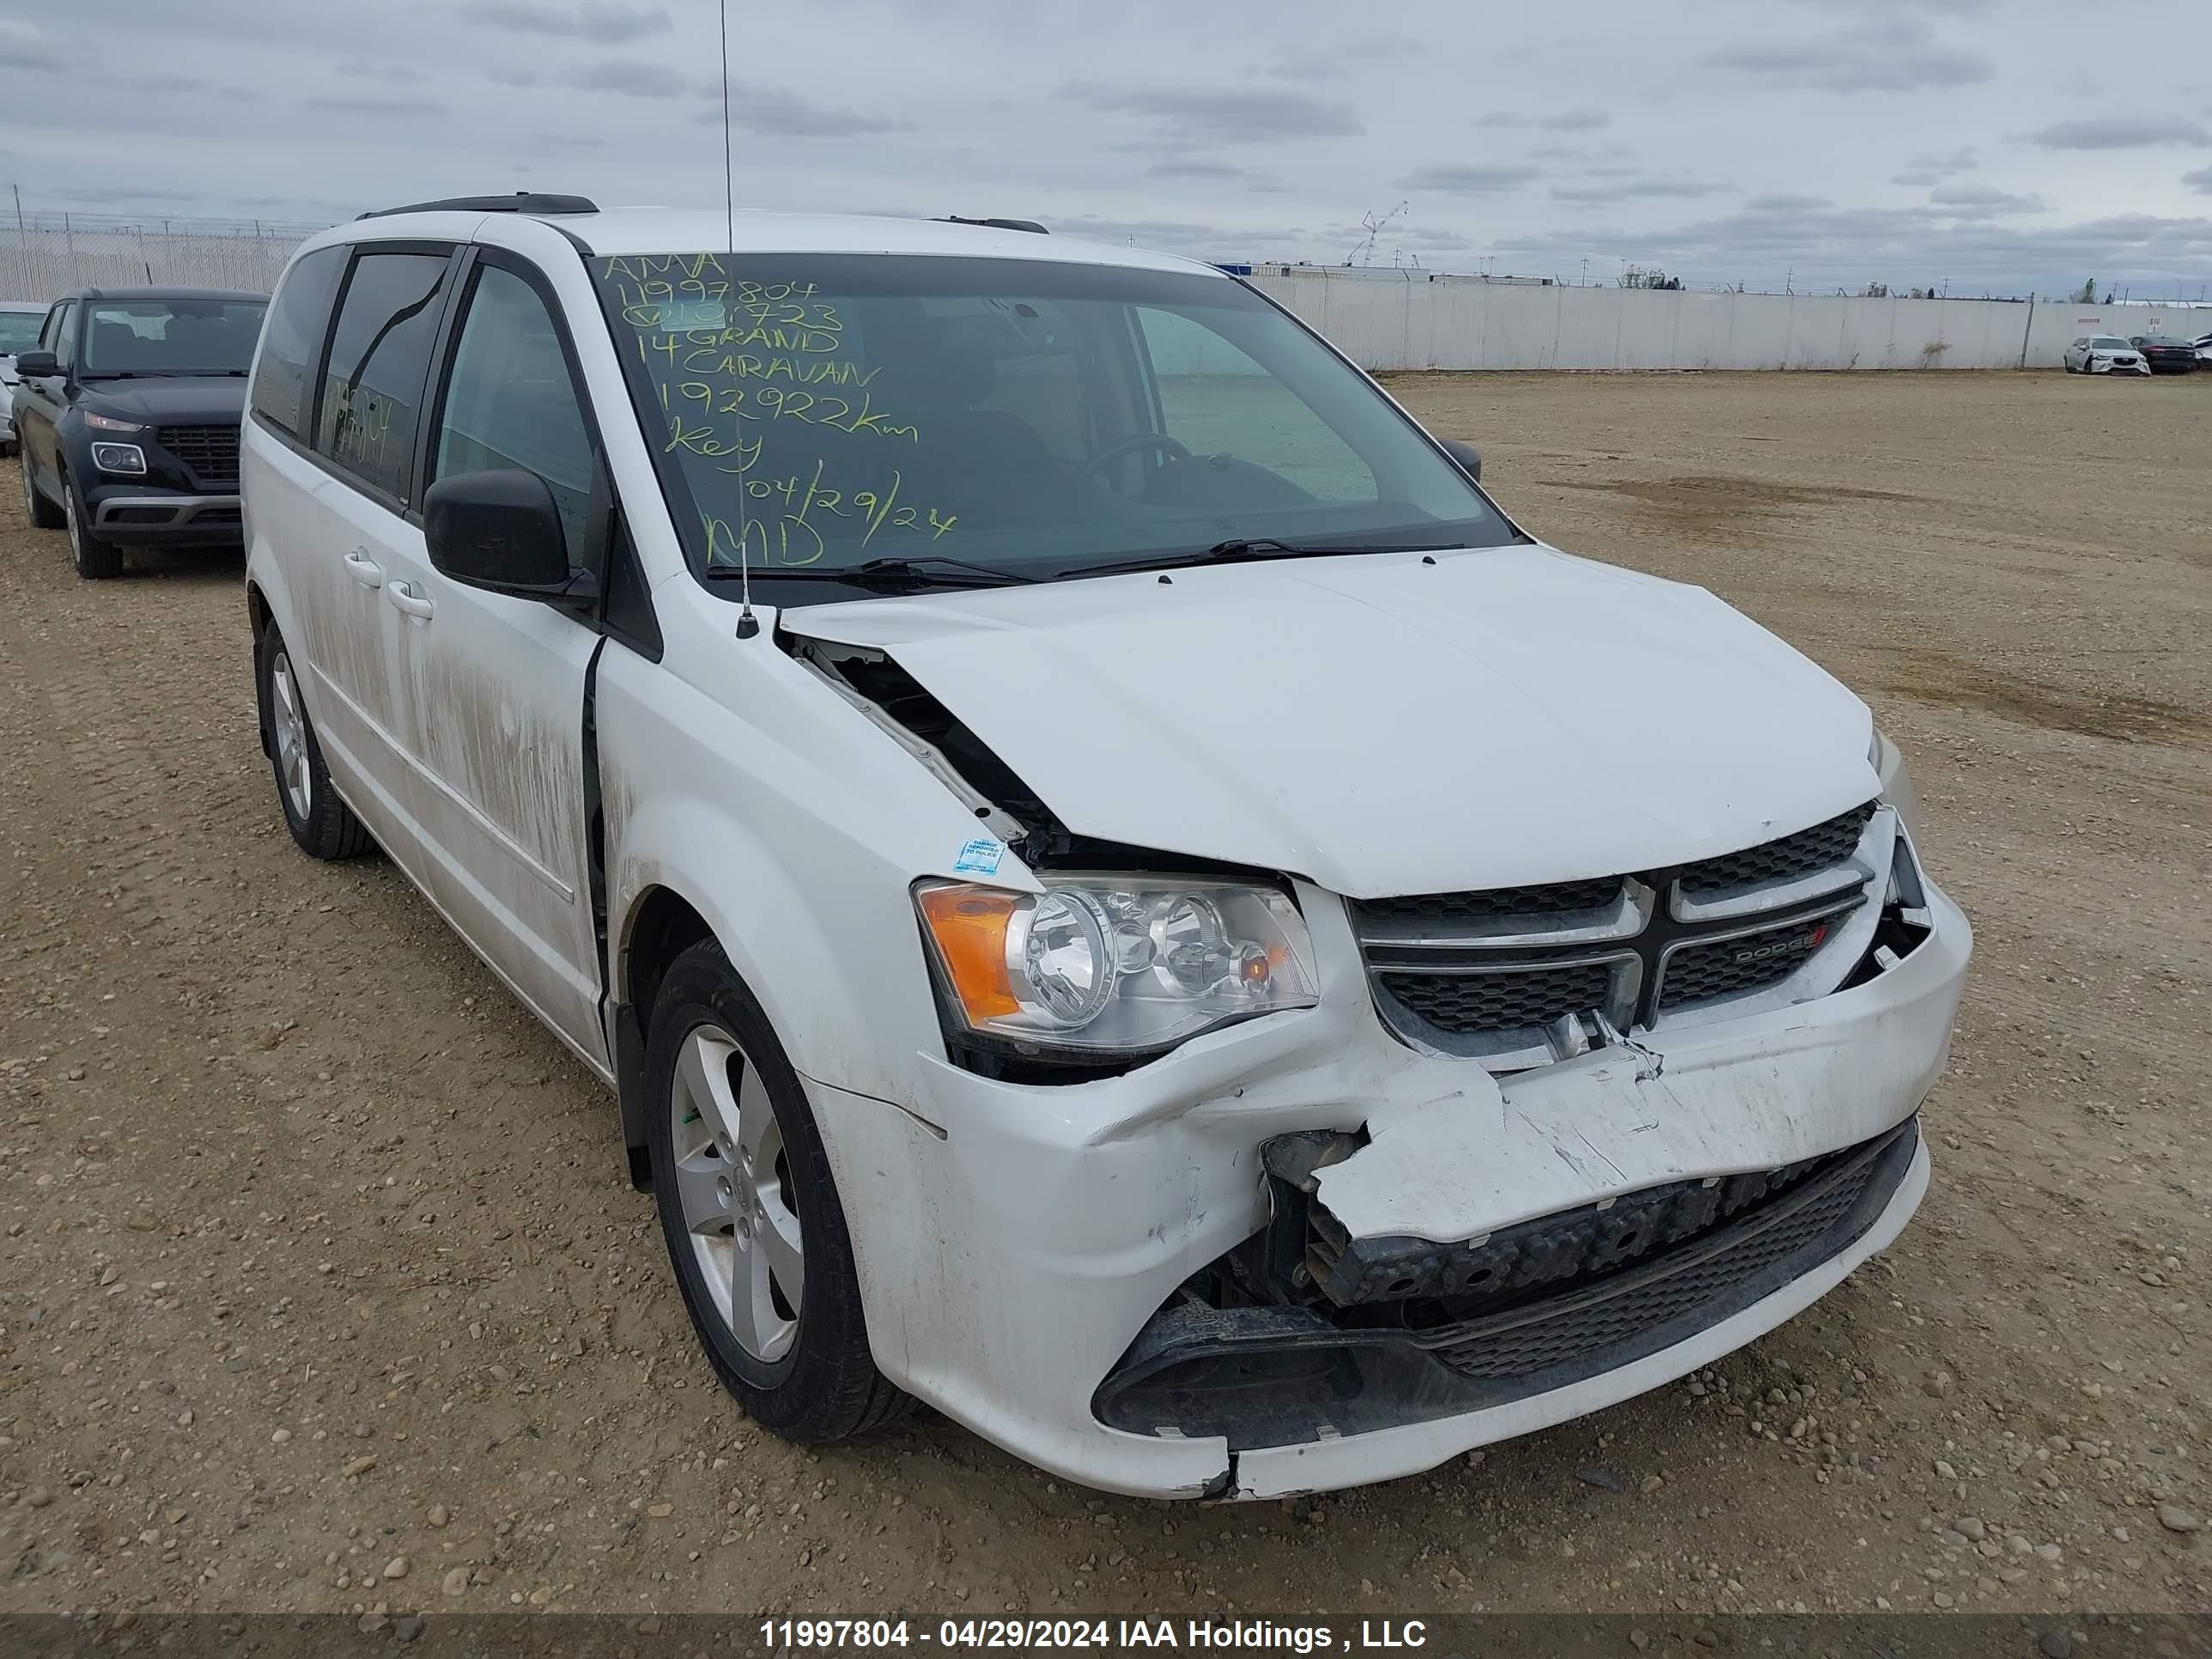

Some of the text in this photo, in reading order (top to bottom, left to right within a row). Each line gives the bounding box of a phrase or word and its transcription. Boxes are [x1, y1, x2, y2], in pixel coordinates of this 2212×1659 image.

[618, 281, 819, 307] 11997804
[687, 328, 839, 353] GRAND
[684, 349, 884, 387] CARAVAN
[745, 459, 957, 548] 04/29/24
[969, 844, 999, 854] REPORTED
[1735, 935, 1818, 963] DODGE
